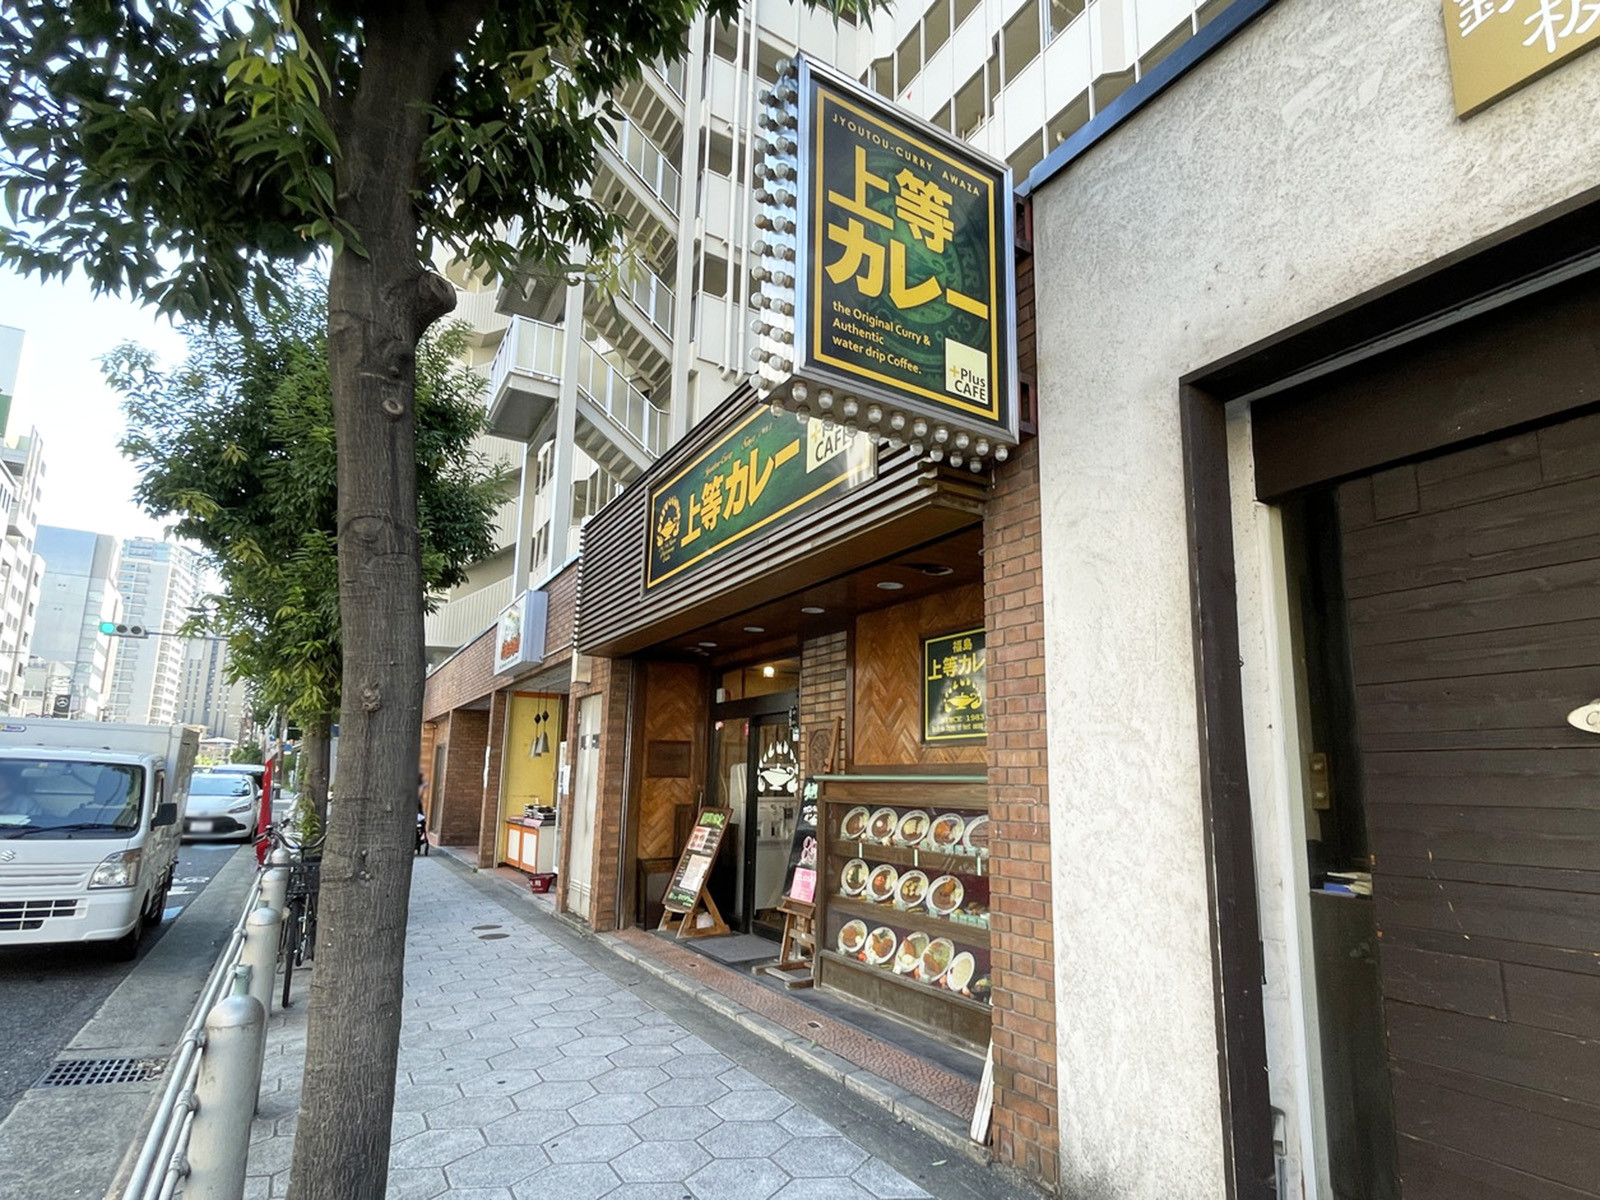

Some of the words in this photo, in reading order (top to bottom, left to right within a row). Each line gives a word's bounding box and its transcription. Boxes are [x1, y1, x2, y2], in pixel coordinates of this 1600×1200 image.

[832, 113, 933, 171] JYOUTOU-CURRY
[942, 170, 980, 197] AWAZA
[828, 145, 955, 254] 上等
[825, 217, 989, 320] カレー
[832, 300, 851, 316] the
[853, 308, 894, 332] Original
[895, 325, 922, 345] Curry
[923, 334, 931, 347] &
[832, 318, 885, 345] Authentic
[832, 335, 864, 353] water
[865, 346, 886, 363] drip
[887, 353, 922, 375] Coffee.
[954, 379, 986, 401] CAFE
[680, 438, 800, 548] 上等カレー
[953, 637, 973, 653] 福島
